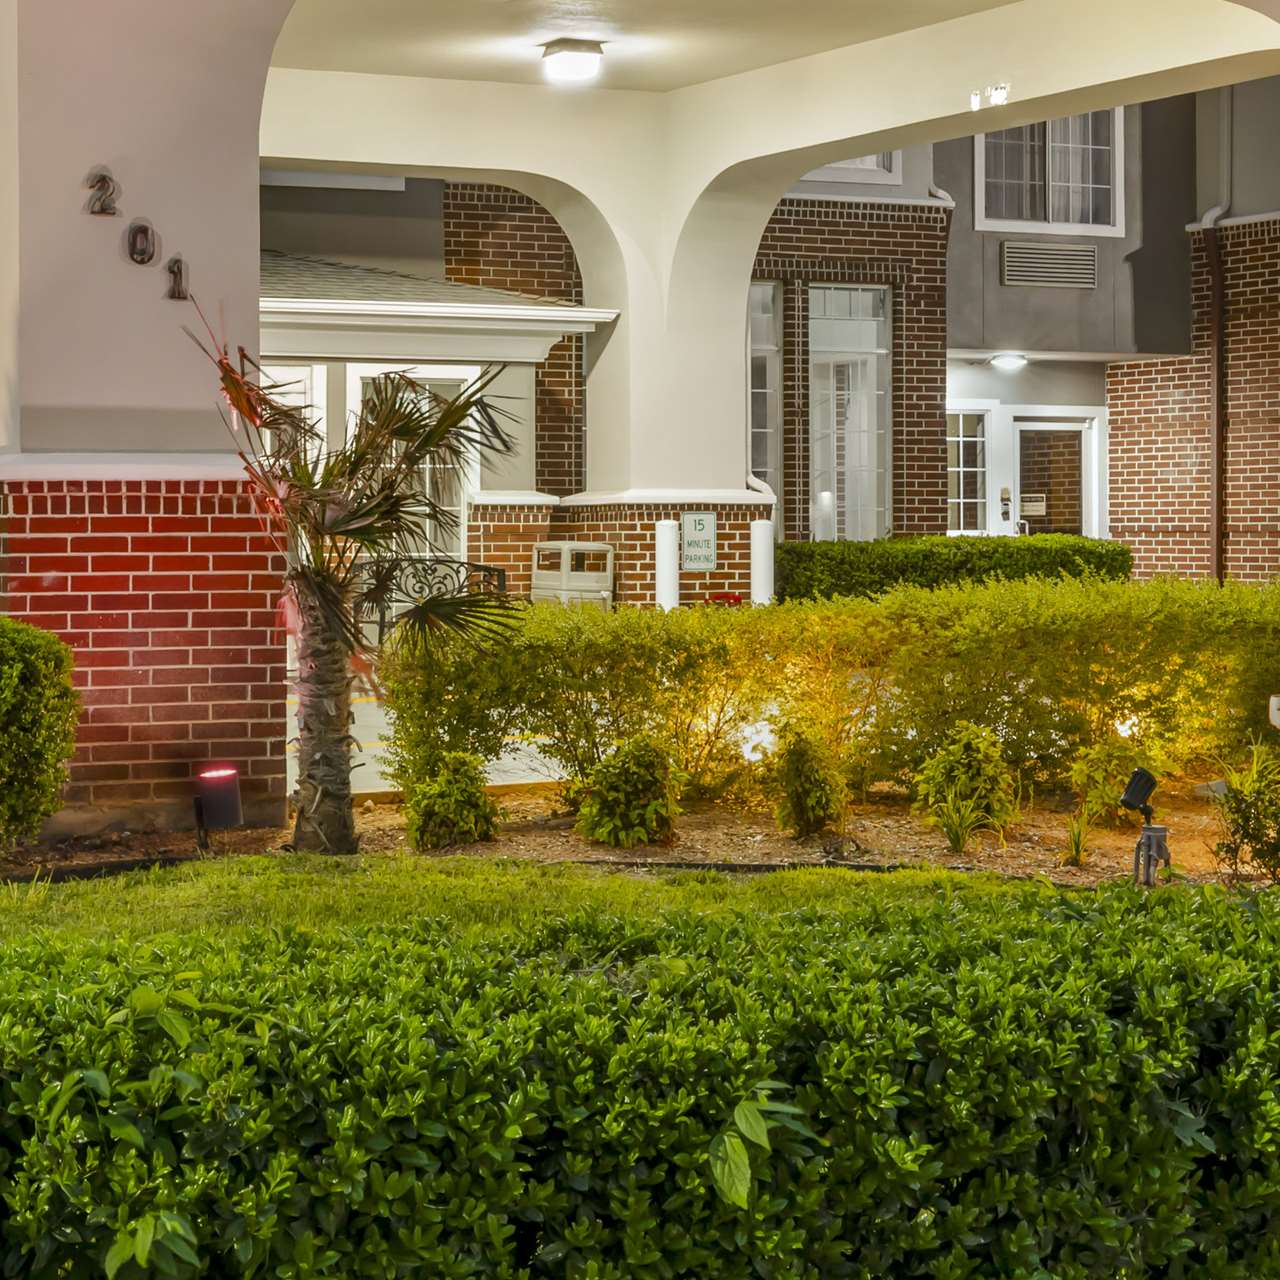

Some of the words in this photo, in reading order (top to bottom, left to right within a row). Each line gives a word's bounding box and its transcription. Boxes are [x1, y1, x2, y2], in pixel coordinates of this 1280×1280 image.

[86, 169, 188, 300] 201
[694, 519, 705, 531] 15
[687, 539, 711, 549] MINUTE
[685, 554, 714, 564] PARKING
